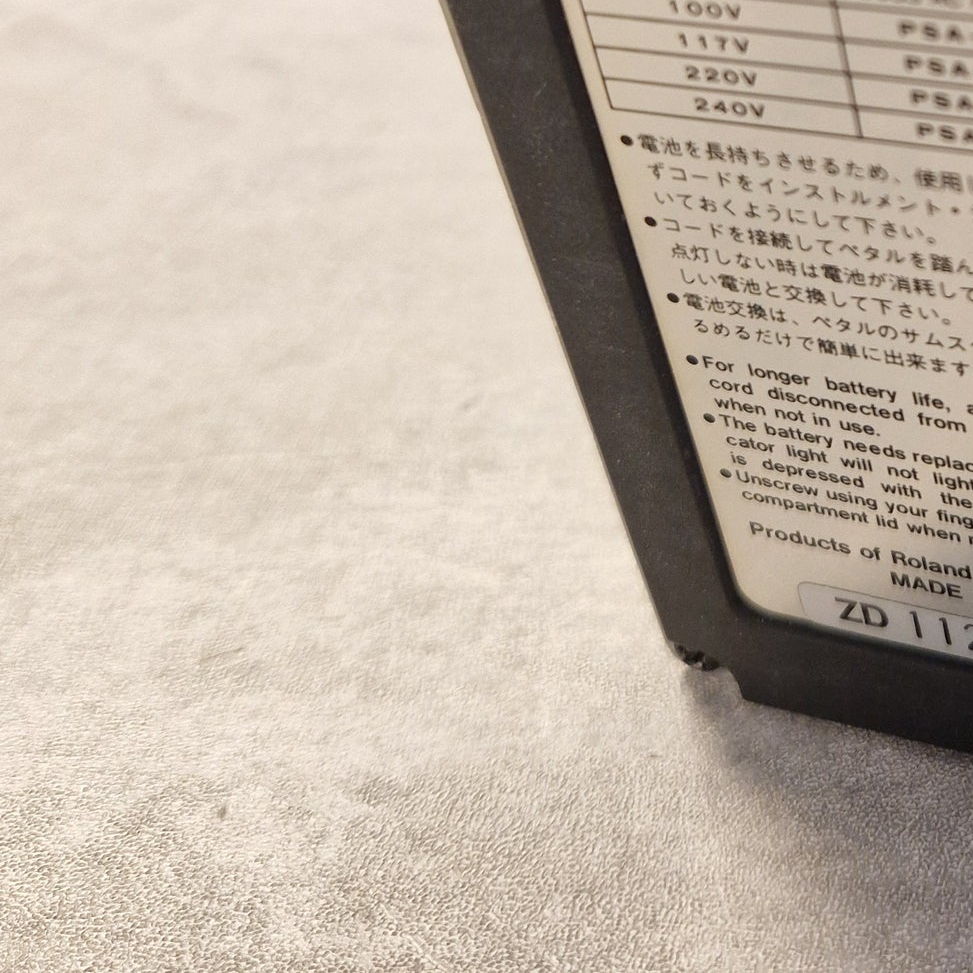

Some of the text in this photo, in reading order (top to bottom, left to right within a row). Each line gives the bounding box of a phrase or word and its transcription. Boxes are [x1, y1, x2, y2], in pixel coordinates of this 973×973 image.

[669, 0, 742, 19] 100V
[677, 32, 749, 53] 117V
[685, 65, 757, 86] 220V
[694, 97, 765, 118] 240V
[702, 355, 735, 373] For
[748, 363, 811, 386] longer
[825, 376, 897, 403] battery
[911, 391, 951, 413] life,
[709, 377, 754, 395] cord
[767, 386, 905, 422] disconnected
[918, 411, 967, 433] from
[714, 395, 881, 437] when not in use.
[718, 413, 757, 432] The
[764, 421, 834, 449] battery
[843, 438, 906, 461] needs
[726, 434, 775, 454] cator
[785, 444, 829, 465] light
[840, 454, 873, 473] will
[887, 465, 920, 481] not
[730, 451, 747, 466] is
[762, 458, 865, 489] depressed
[881, 480, 923, 500] with
[940, 491, 973, 509] the
[736, 469, 819, 497] Unscrew
[826, 489, 878, 510] using
[885, 499, 929, 519] your
[742, 489, 869, 524] compartment
[875, 513, 899, 530] lid
[907, 522, 961, 543] when
[749, 521, 972, 580] Products of Roland
[889, 571, 963, 599] MADE
[834, 596, 888, 628] ZD
